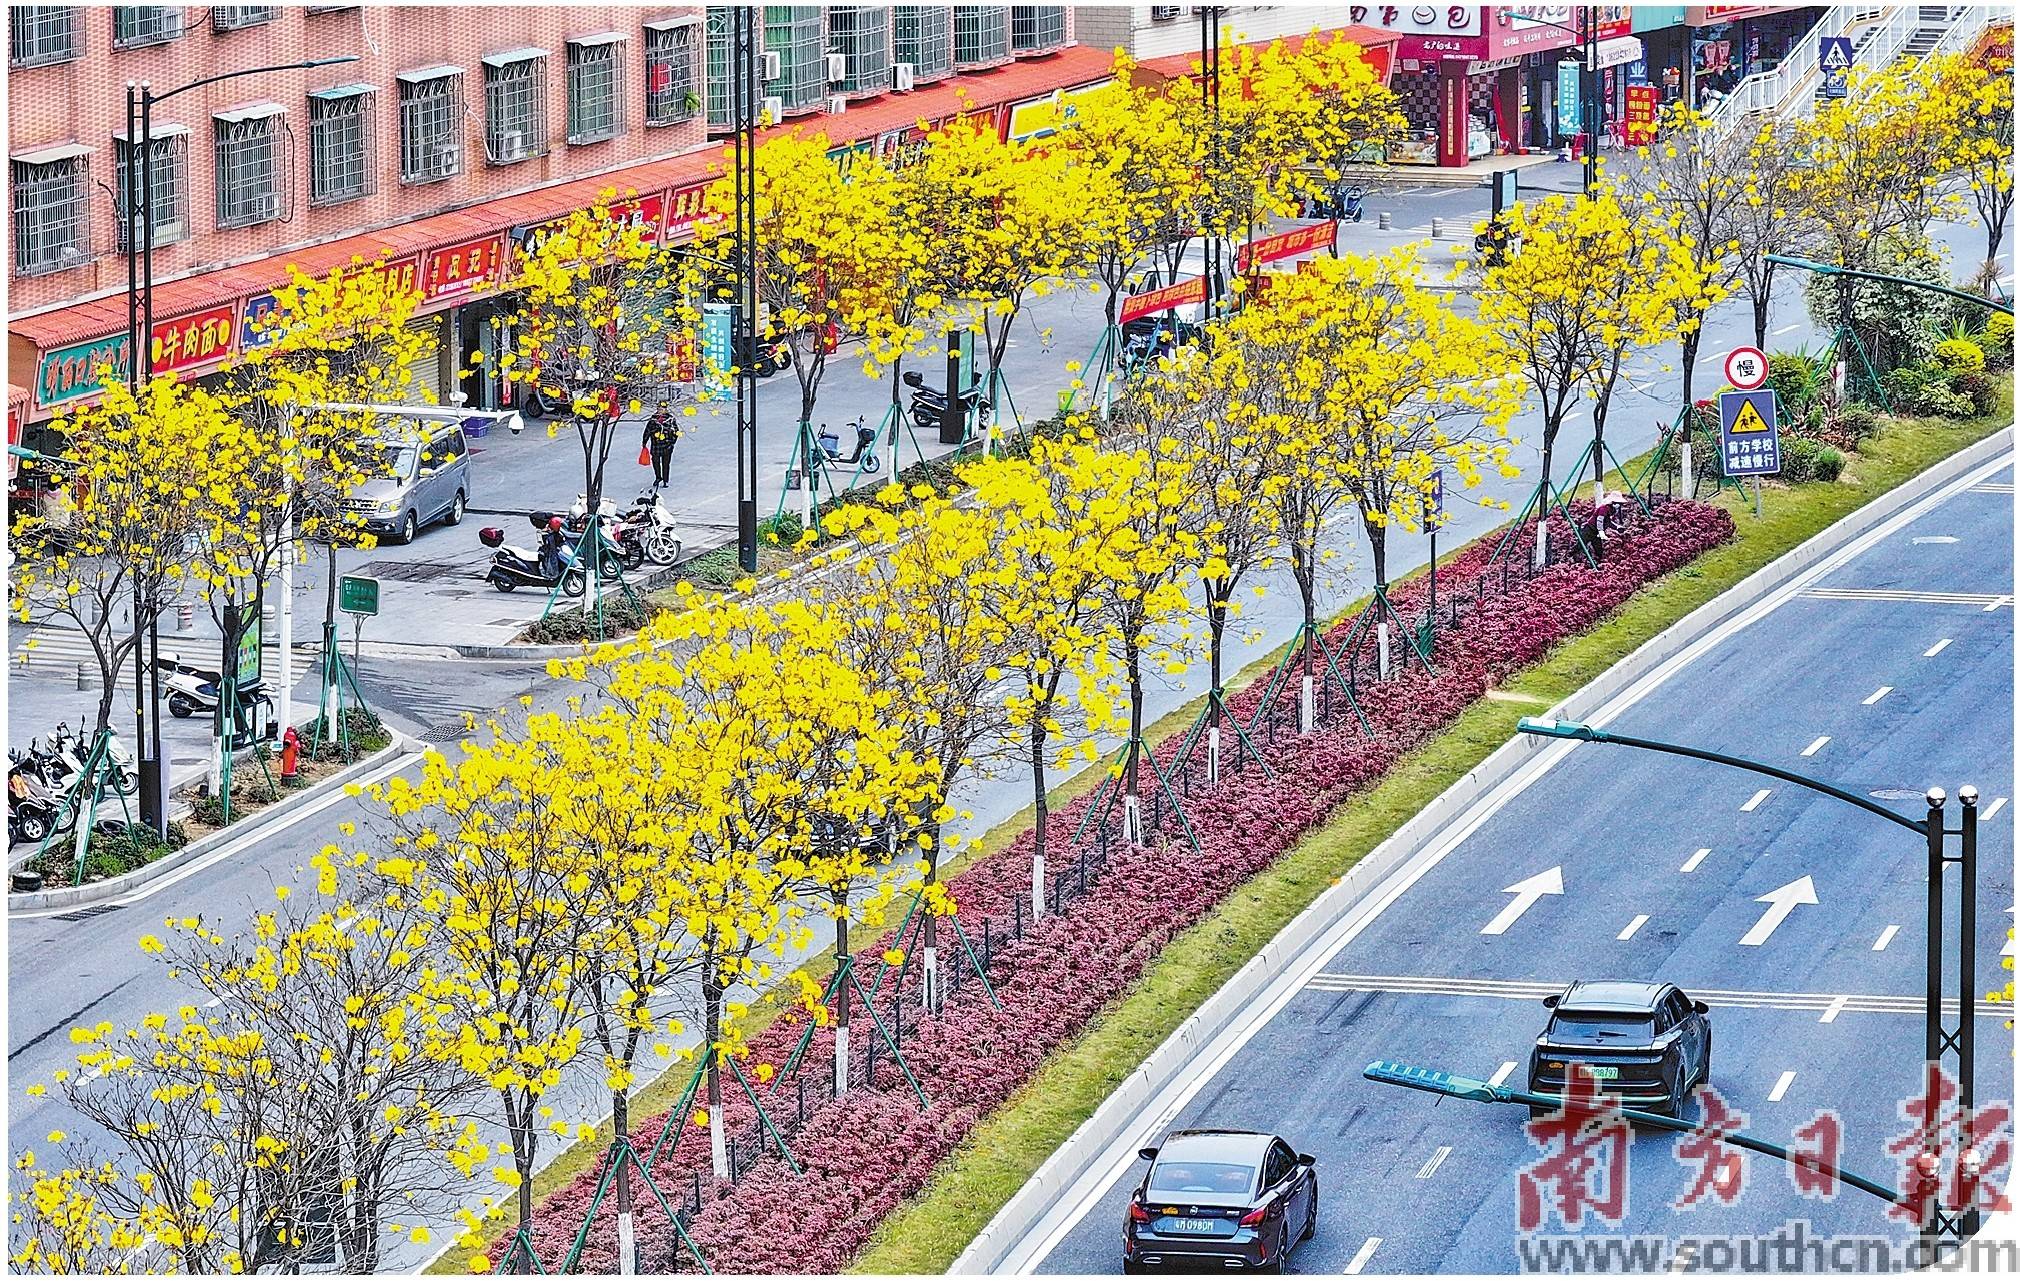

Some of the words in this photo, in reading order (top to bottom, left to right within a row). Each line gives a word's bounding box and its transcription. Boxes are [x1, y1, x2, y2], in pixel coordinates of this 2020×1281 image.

[162, 317, 219, 367] 牛肉面
[1736, 359, 1756, 378] 慢
[1728, 437, 1774, 454] 前方学校
[1728, 453, 1775, 470] 减速慢行
